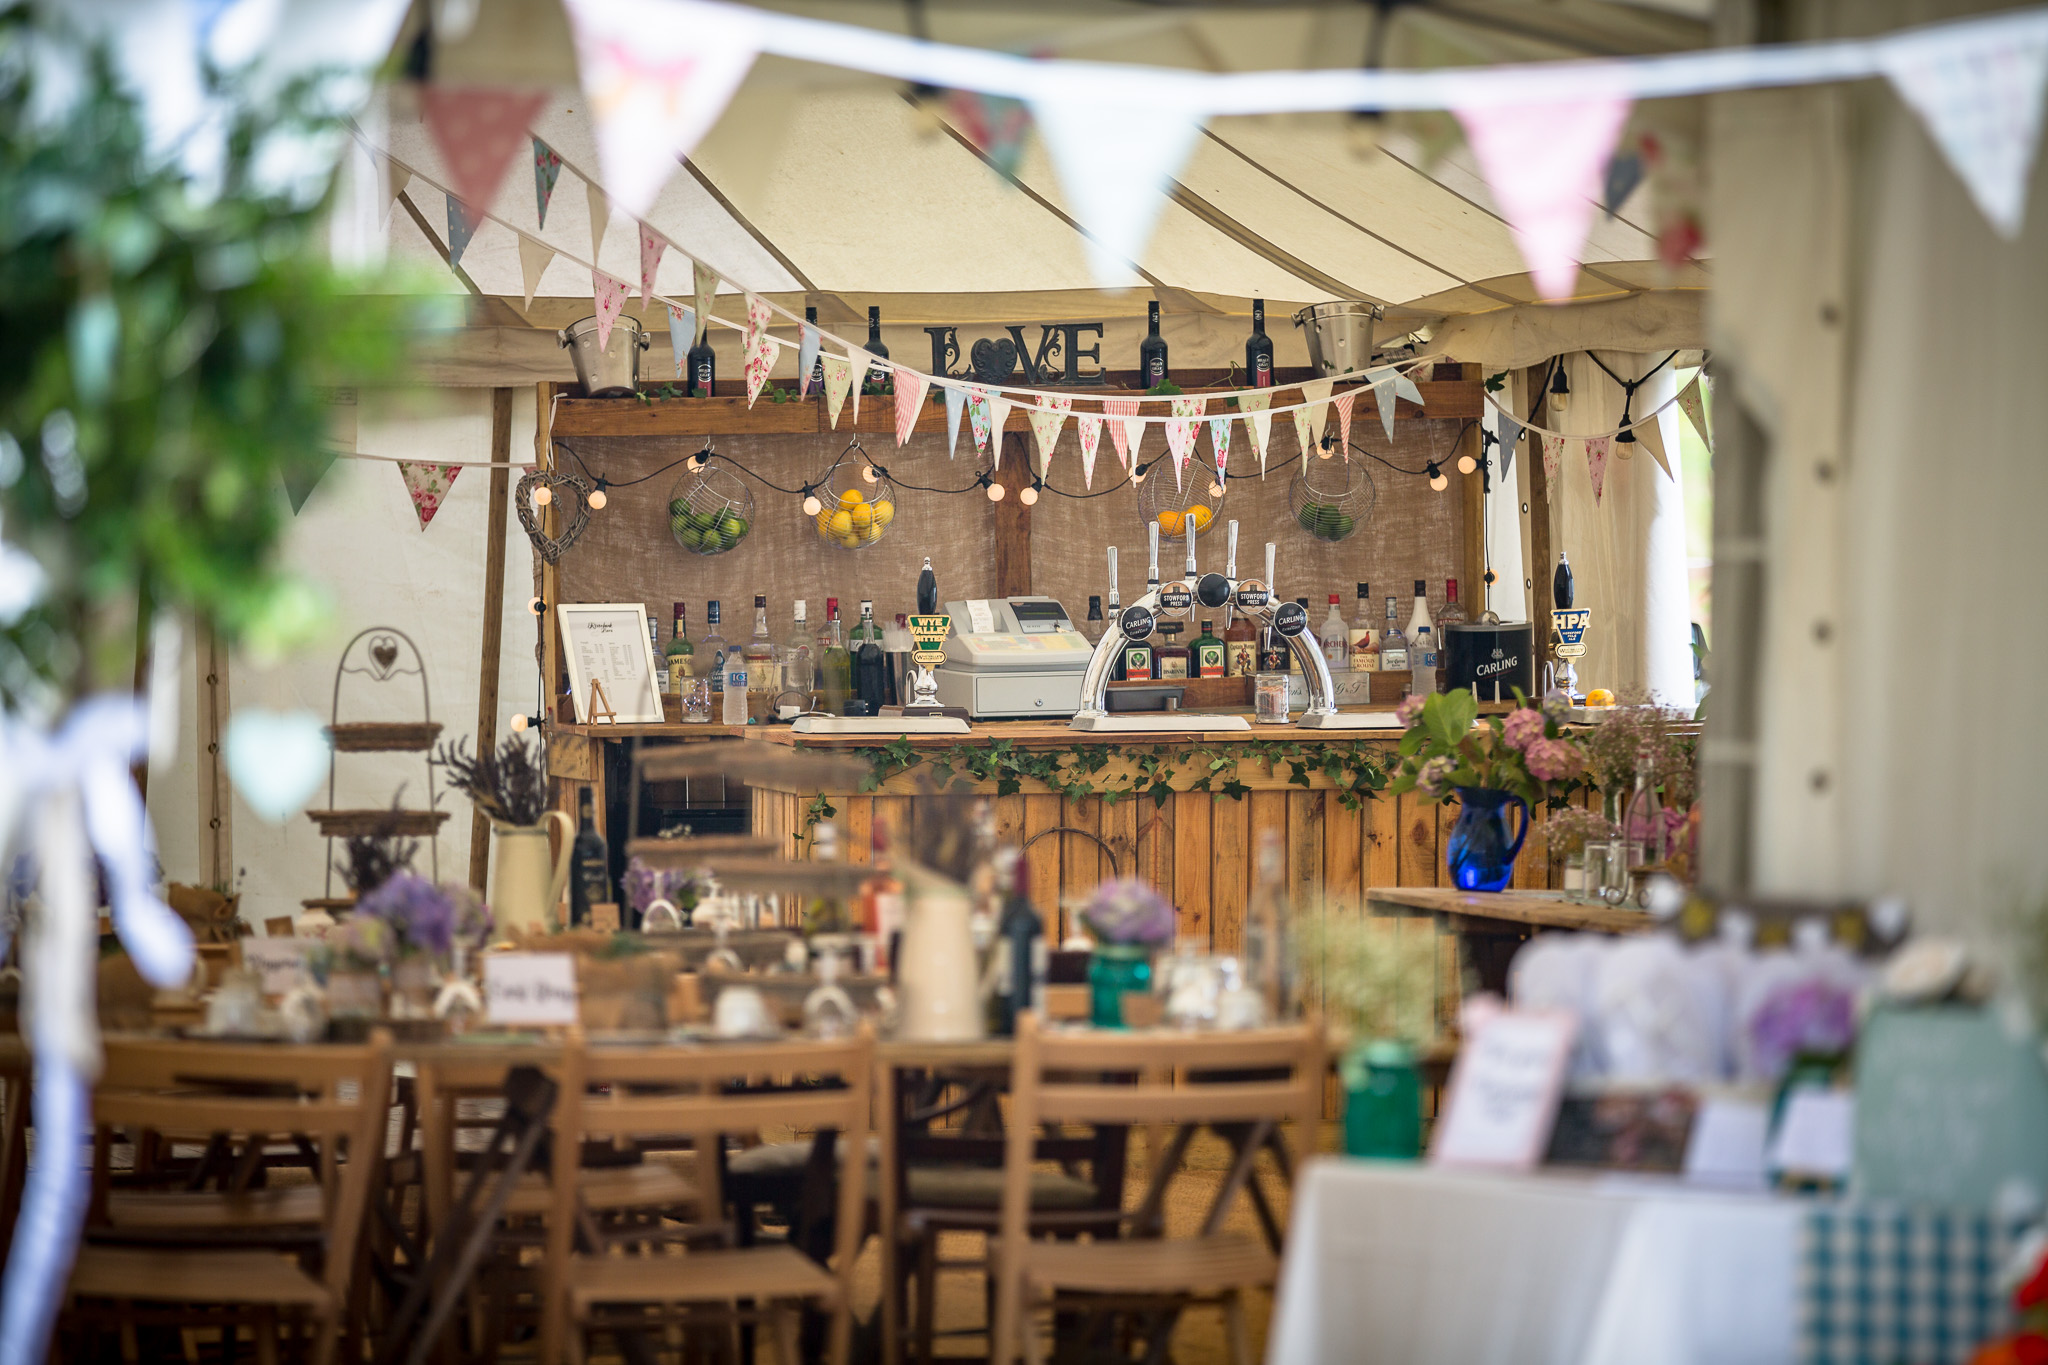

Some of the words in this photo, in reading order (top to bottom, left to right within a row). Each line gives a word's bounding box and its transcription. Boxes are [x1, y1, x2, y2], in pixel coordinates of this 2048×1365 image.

[918, 618, 943, 626] WYE
[1126, 617, 1151, 629] CARLING
[1278, 614, 1304, 625] CARLING
[1551, 613, 1590, 629] HPA
[908, 626, 950, 634] VALLEY
[1476, 656, 1518, 676] CARLING
